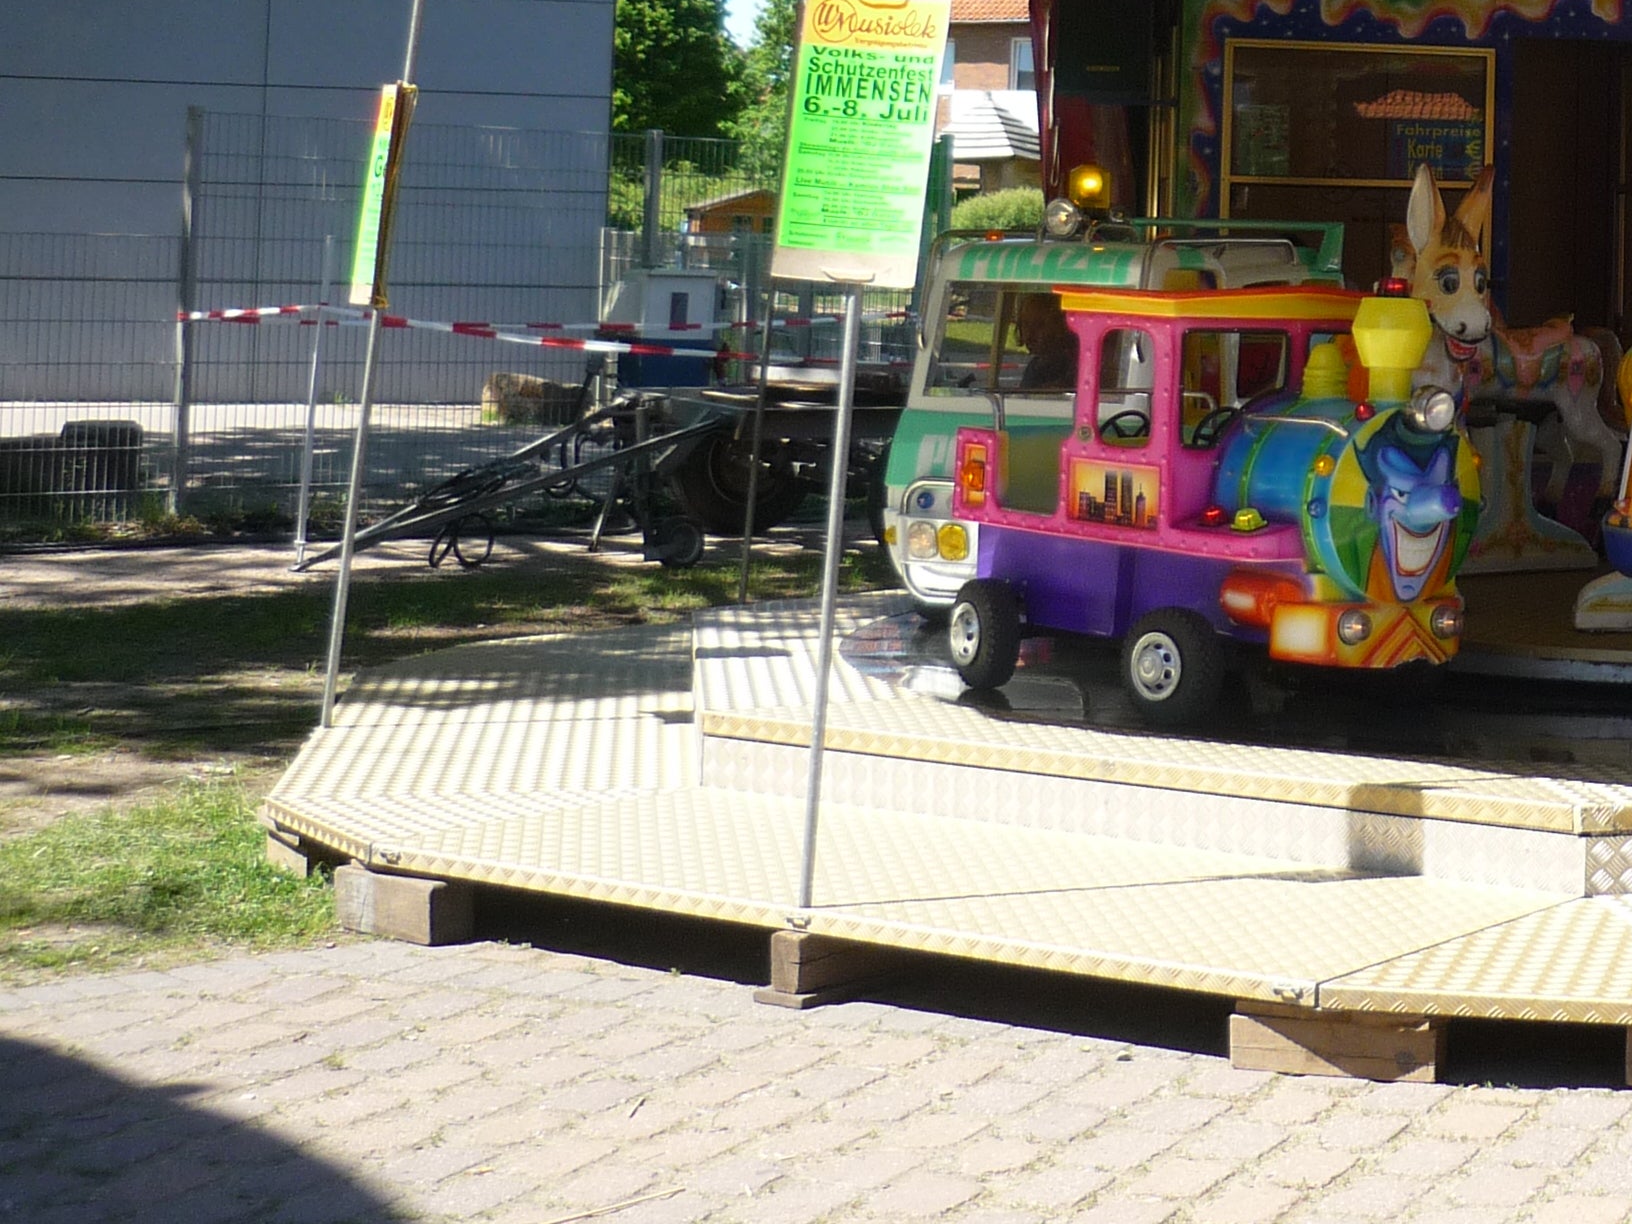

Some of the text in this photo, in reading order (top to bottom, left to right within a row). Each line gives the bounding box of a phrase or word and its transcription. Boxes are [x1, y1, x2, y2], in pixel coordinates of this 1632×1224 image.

[812, 45, 934, 64] Volks- und
[806, 73, 932, 104] IMMENSEN
[804, 96, 928, 122] 6.-8. Juli
[1397, 123, 1482, 138] Fahrpreise
[1408, 137, 1443, 158] Karte
